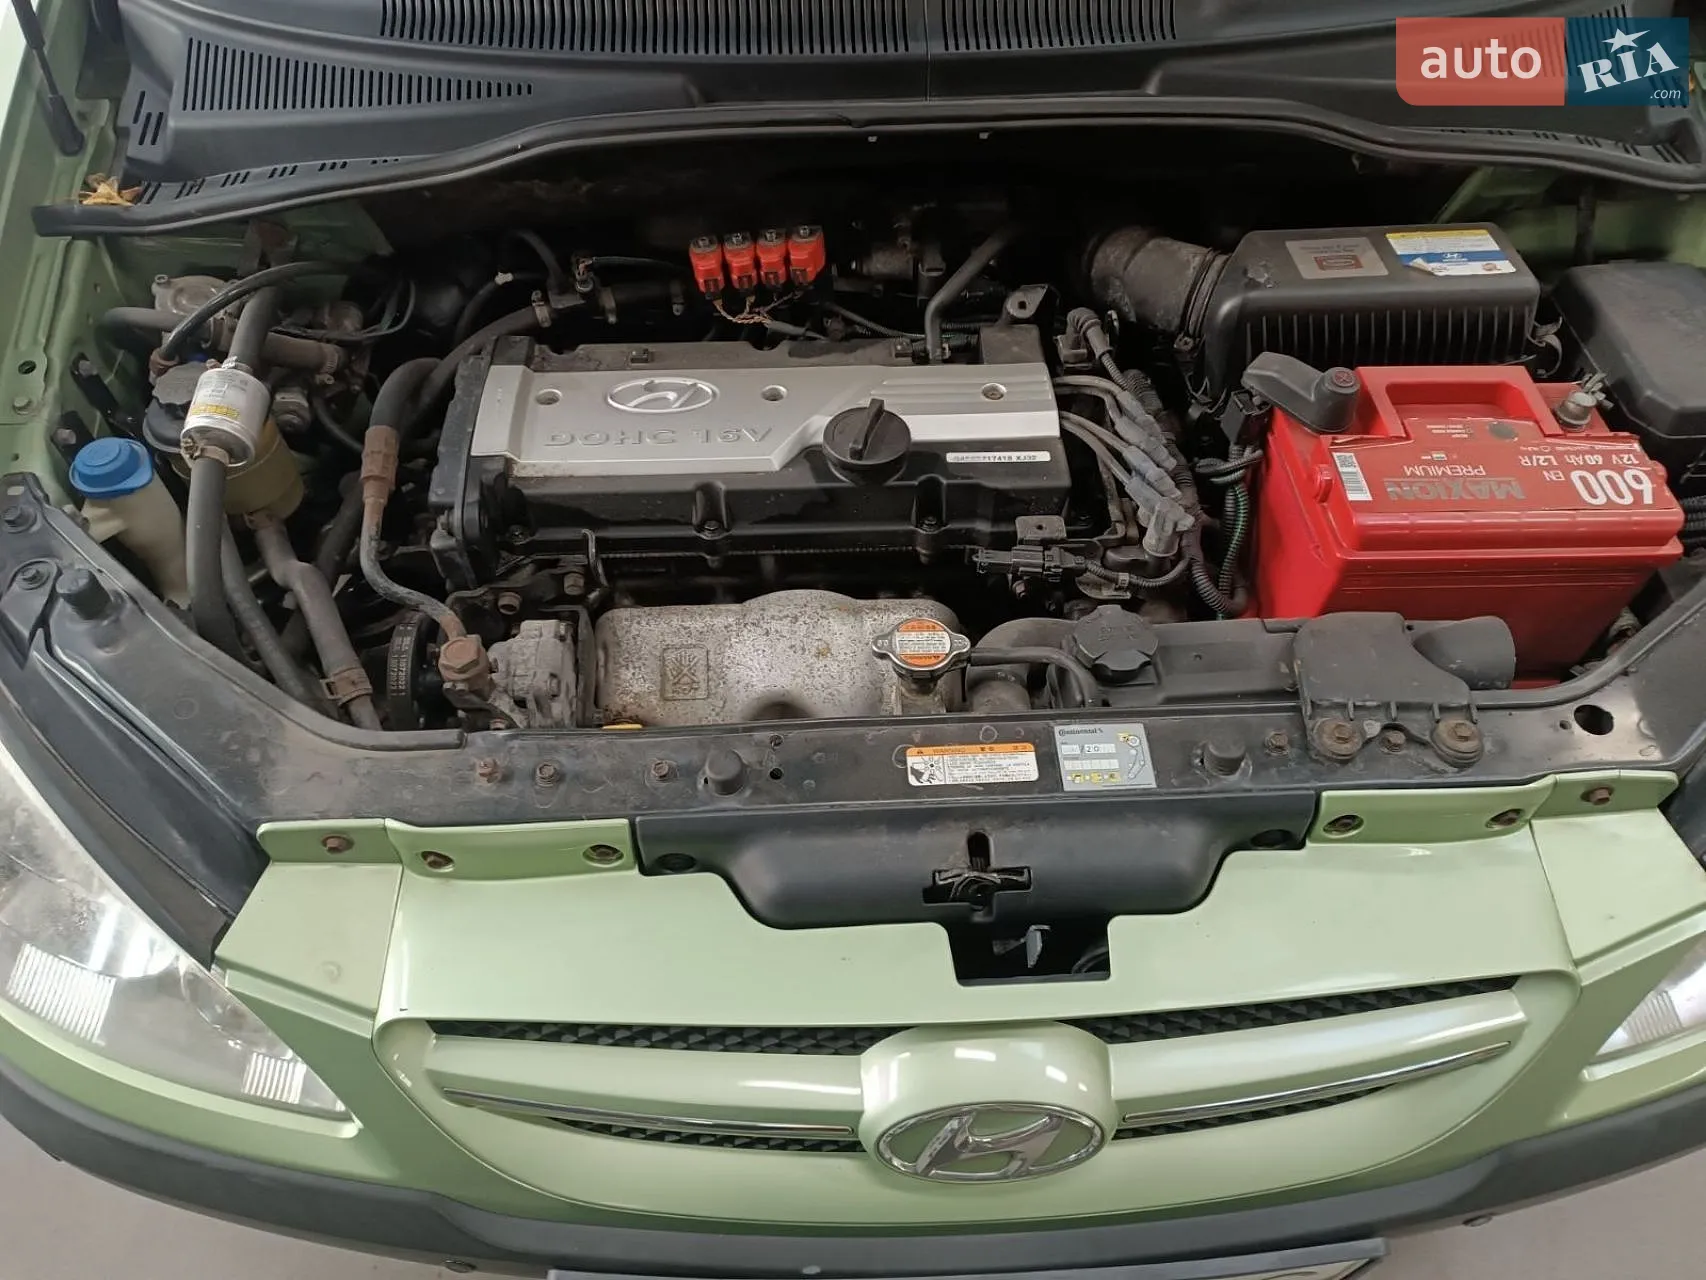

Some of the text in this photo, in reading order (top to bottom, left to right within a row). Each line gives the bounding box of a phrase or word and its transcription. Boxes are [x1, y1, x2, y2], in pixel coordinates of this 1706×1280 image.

[1403, 464, 1487, 477] PREMIUM
[1383, 481, 1526, 501] MAXION
[1542, 469, 1653, 506] 600 EN
